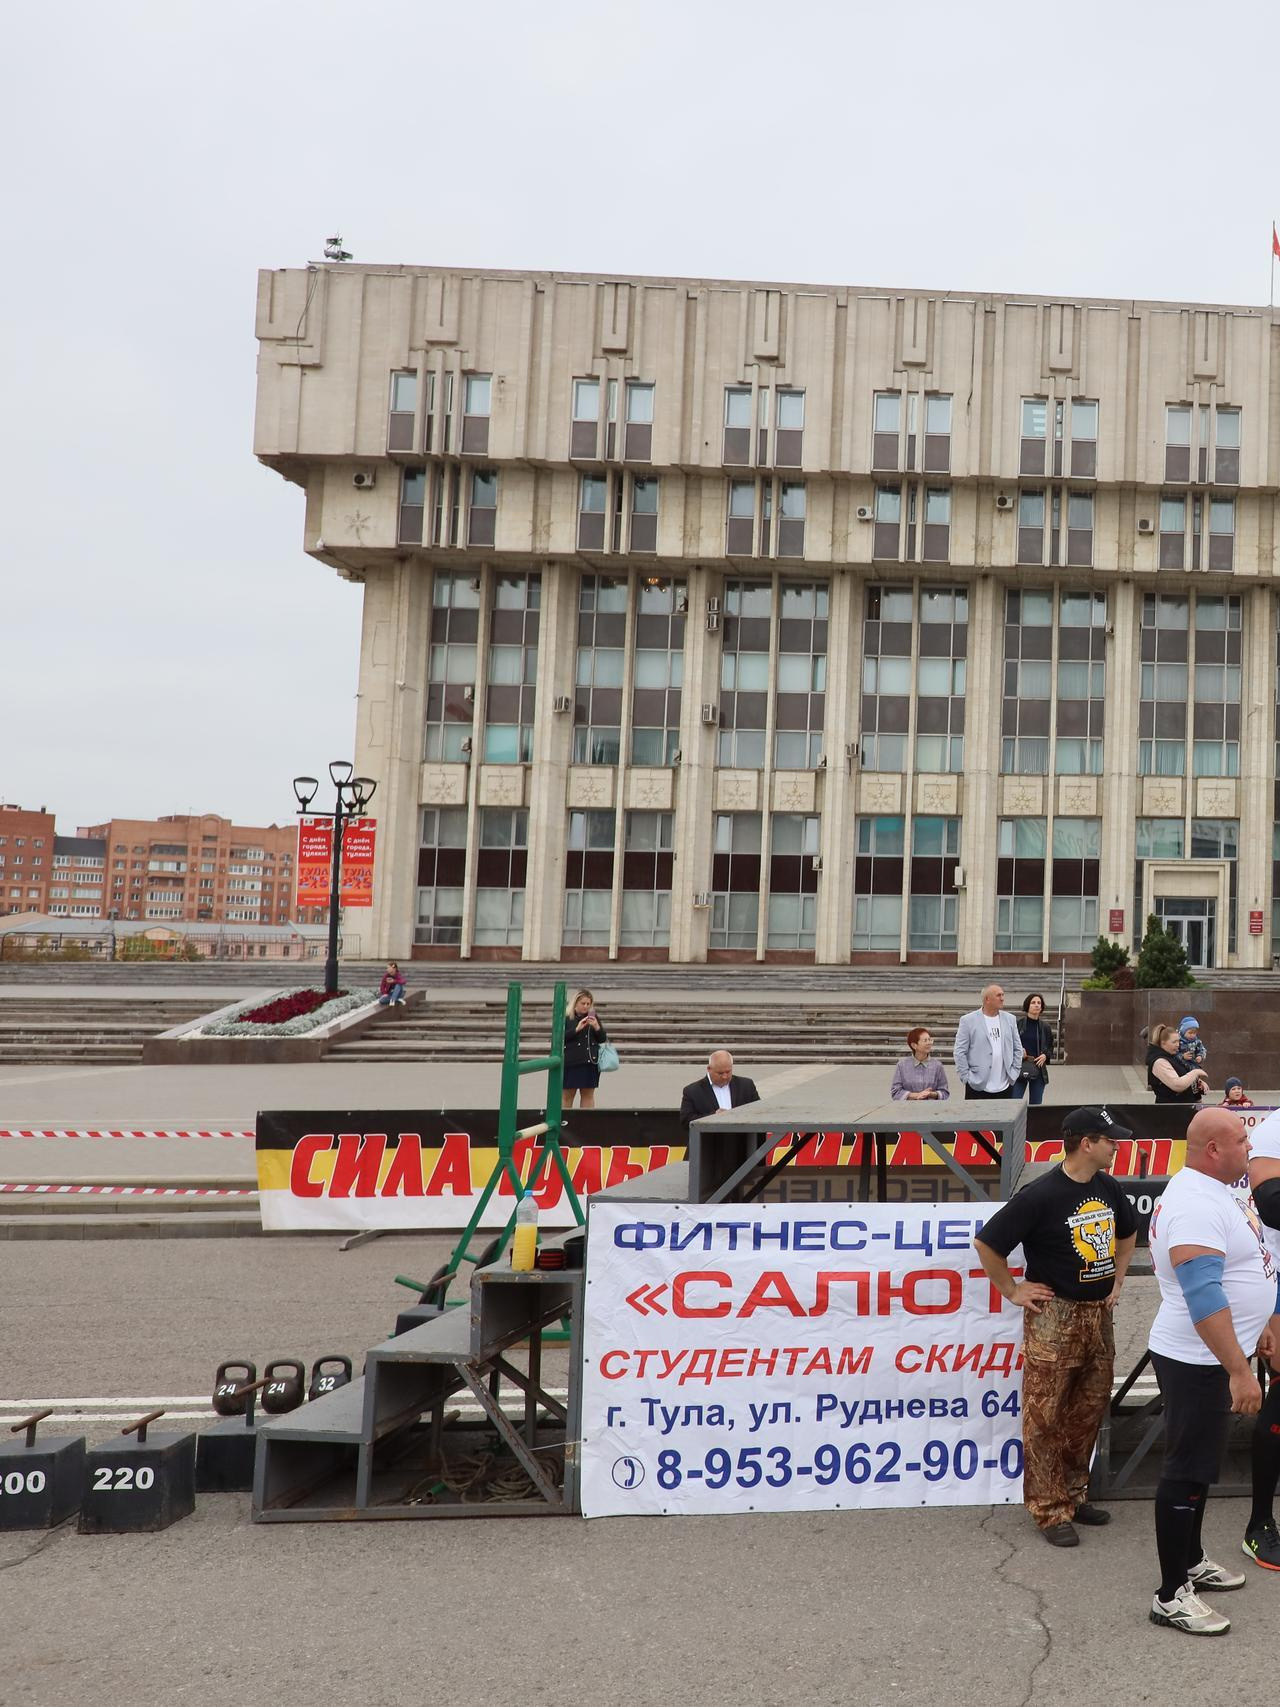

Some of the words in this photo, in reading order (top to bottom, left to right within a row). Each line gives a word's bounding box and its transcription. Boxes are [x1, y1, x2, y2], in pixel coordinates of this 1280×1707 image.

[290, 1133, 474, 1198] СИЛА
[625, 1267, 1024, 1319] «САЛЮТ
[599, 1346, 874, 1386] СТУДЕНТАМ
[218, 1384, 237, 1396] 24
[268, 1383, 286, 1394] 24
[319, 1377, 336, 1391] 32
[607, 1406, 626, 1427] г.
[641, 1397, 735, 1435] Тула,
[748, 1402, 801, 1432] ул.
[816, 1393, 968, 1429] Руднева
[981, 1389, 1021, 1418] 64
[0, 1470, 46, 1496] 00
[92, 1467, 155, 1491] 220
